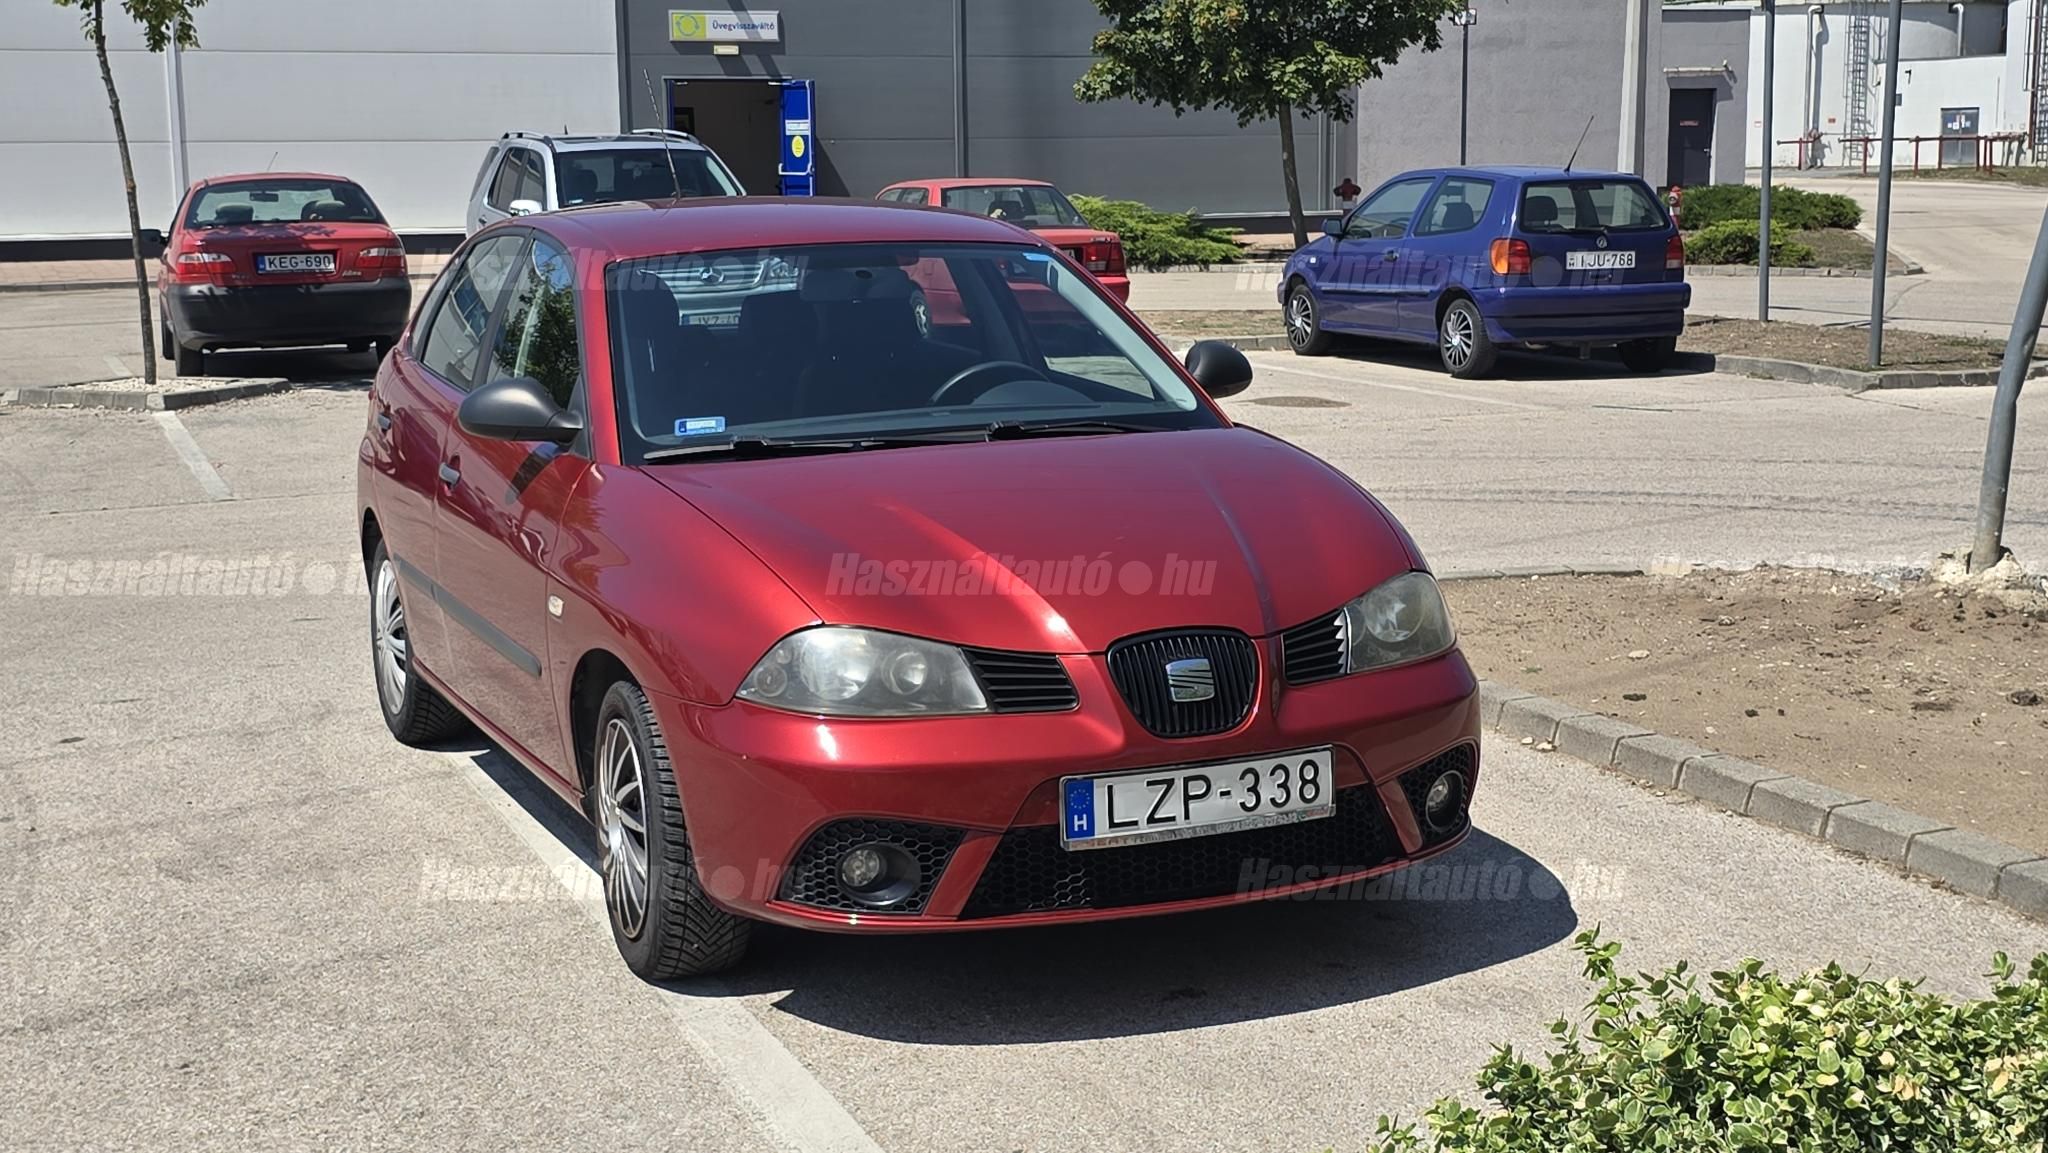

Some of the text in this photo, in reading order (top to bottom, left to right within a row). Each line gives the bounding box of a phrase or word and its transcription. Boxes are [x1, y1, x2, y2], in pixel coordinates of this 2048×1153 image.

[267, 256, 331, 269] KEG-690
[1581, 253, 1633, 267] IJU-768
[1073, 813, 1088, 832] H
[1106, 759, 1320, 830] LZP-338
